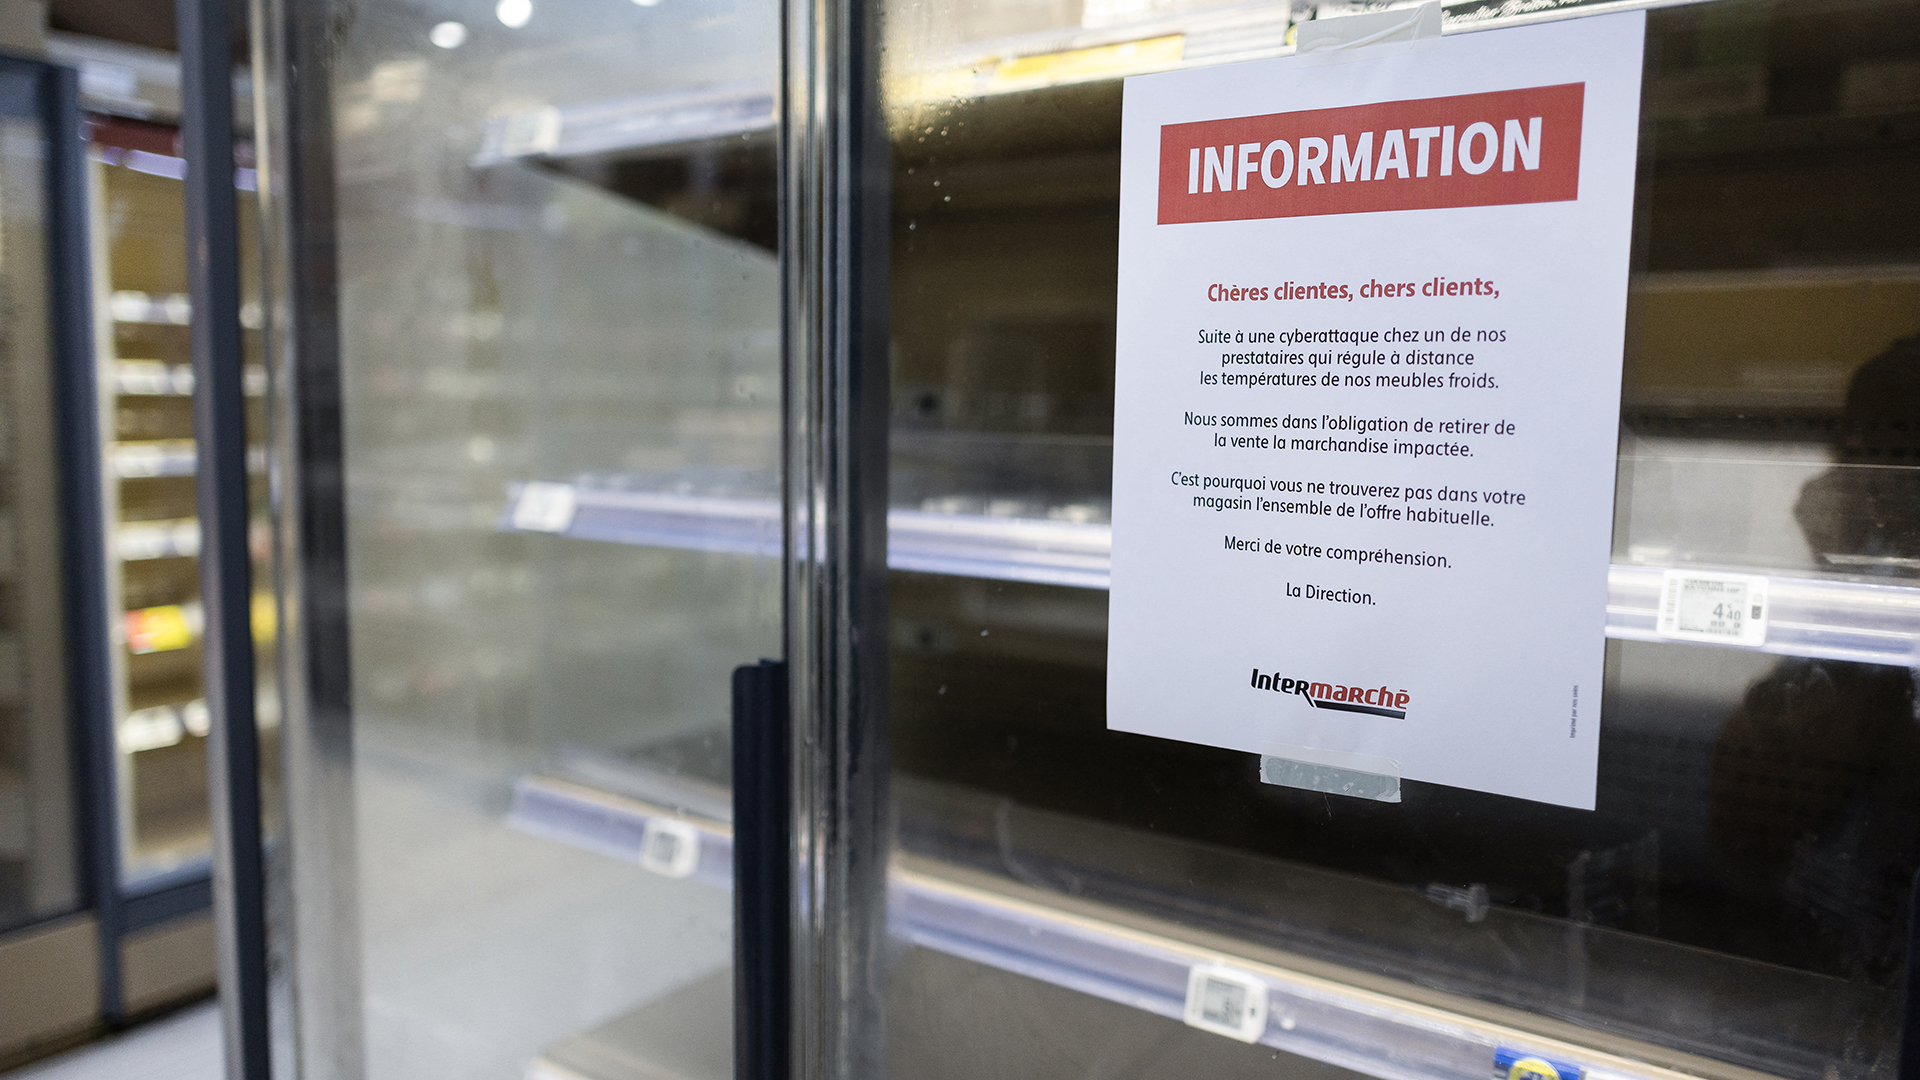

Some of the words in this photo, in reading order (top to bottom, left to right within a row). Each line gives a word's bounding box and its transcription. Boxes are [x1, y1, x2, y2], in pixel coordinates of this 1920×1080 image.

[1187, 116, 1543, 195] INFORMATION
[1207, 283, 1269, 303] Chères
[1273, 280, 1354, 303] clientes,
[1359, 278, 1416, 299] chers
[1421, 276, 1500, 300] clients,
[1197, 328, 1232, 344] Suite
[1234, 329, 1244, 344] à
[1248, 331, 1276, 344] une
[1279, 327, 1379, 347] cyberattaque
[1383, 326, 1420, 343] chez
[1424, 330, 1445, 343] un
[1450, 326, 1472, 343] de
[1476, 329, 1507, 343] nos
[1221, 349, 1305, 368] prestataires
[1308, 349, 1333, 369] qui
[1336, 349, 1386, 369] régule
[1390, 350, 1401, 366] à
[1405, 349, 1475, 366] distance
[1200, 370, 1218, 386] les
[1220, 371, 1317, 389] températures
[1320, 371, 1340, 387] de
[1344, 375, 1371, 388] nos
[1375, 371, 1444, 389] meubles
[1448, 371, 1499, 389] froids.
[1184, 411, 1218, 427] Nous
[1220, 415, 1278, 429] sommes
[1281, 413, 1318, 430] dans
[1413, 416, 1434, 434] de
[1438, 417, 1491, 435] retirer
[1494, 418, 1516, 436] de
[1214, 432, 1227, 448] la
[1230, 435, 1269, 450] vente
[1273, 434, 1286, 450] la
[1290, 436, 1389, 454] marchandise
[1393, 438, 1474, 459] impactée.
[1203, 475, 1266, 493] pourquoi
[1269, 479, 1303, 493] vous
[1306, 481, 1326, 495] ne
[1328, 480, 1400, 499] trouverez
[1404, 487, 1433, 503] pas
[1437, 485, 1478, 503] dans
[1482, 489, 1526, 506] votre
[1193, 495, 1252, 512] magasin
[1336, 501, 1356, 518] de
[1406, 505, 1495, 527] habituelle.
[1224, 535, 1261, 553] Merci
[1264, 538, 1282, 555] de
[1285, 542, 1322, 558] votre
[1326, 547, 1452, 569] compréhension.
[1286, 581, 1301, 598] La
[1305, 583, 1376, 606] Direction.
[1250, 668, 1411, 711] Intermarché
